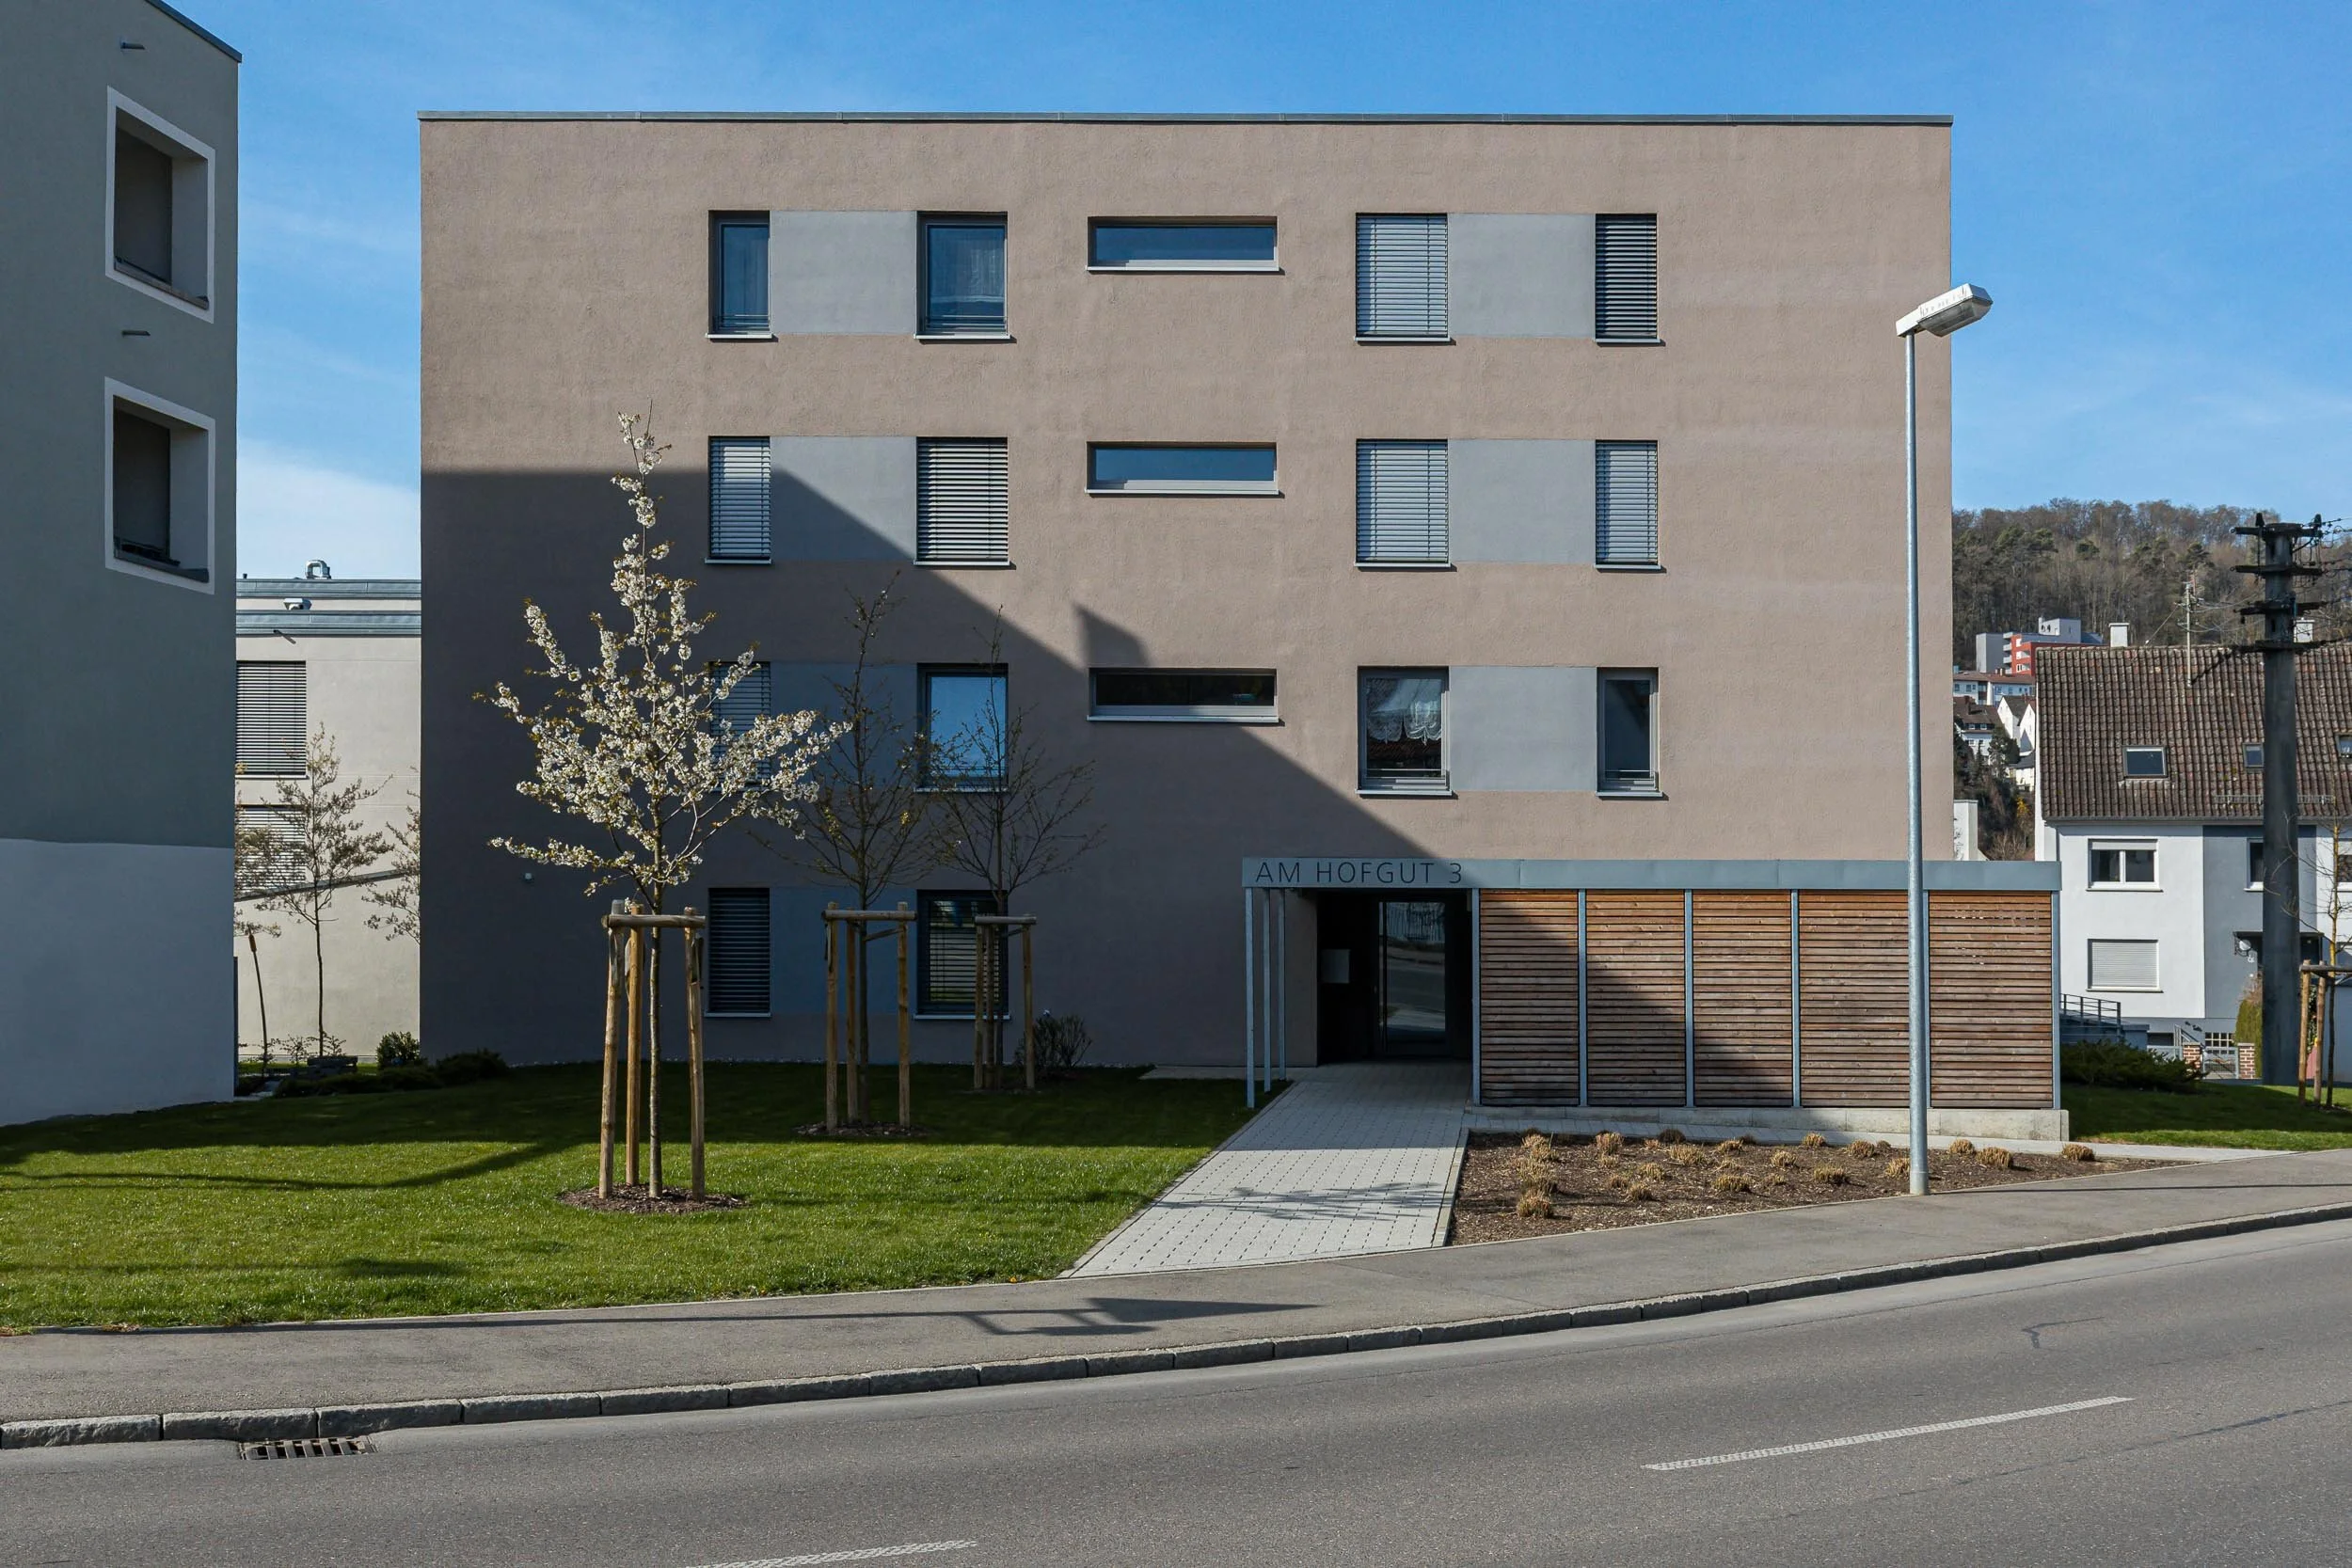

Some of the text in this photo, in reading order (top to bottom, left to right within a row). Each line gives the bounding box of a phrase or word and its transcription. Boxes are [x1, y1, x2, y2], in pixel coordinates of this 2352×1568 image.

[1256, 862, 1461, 883] AM HOFGUT 3
